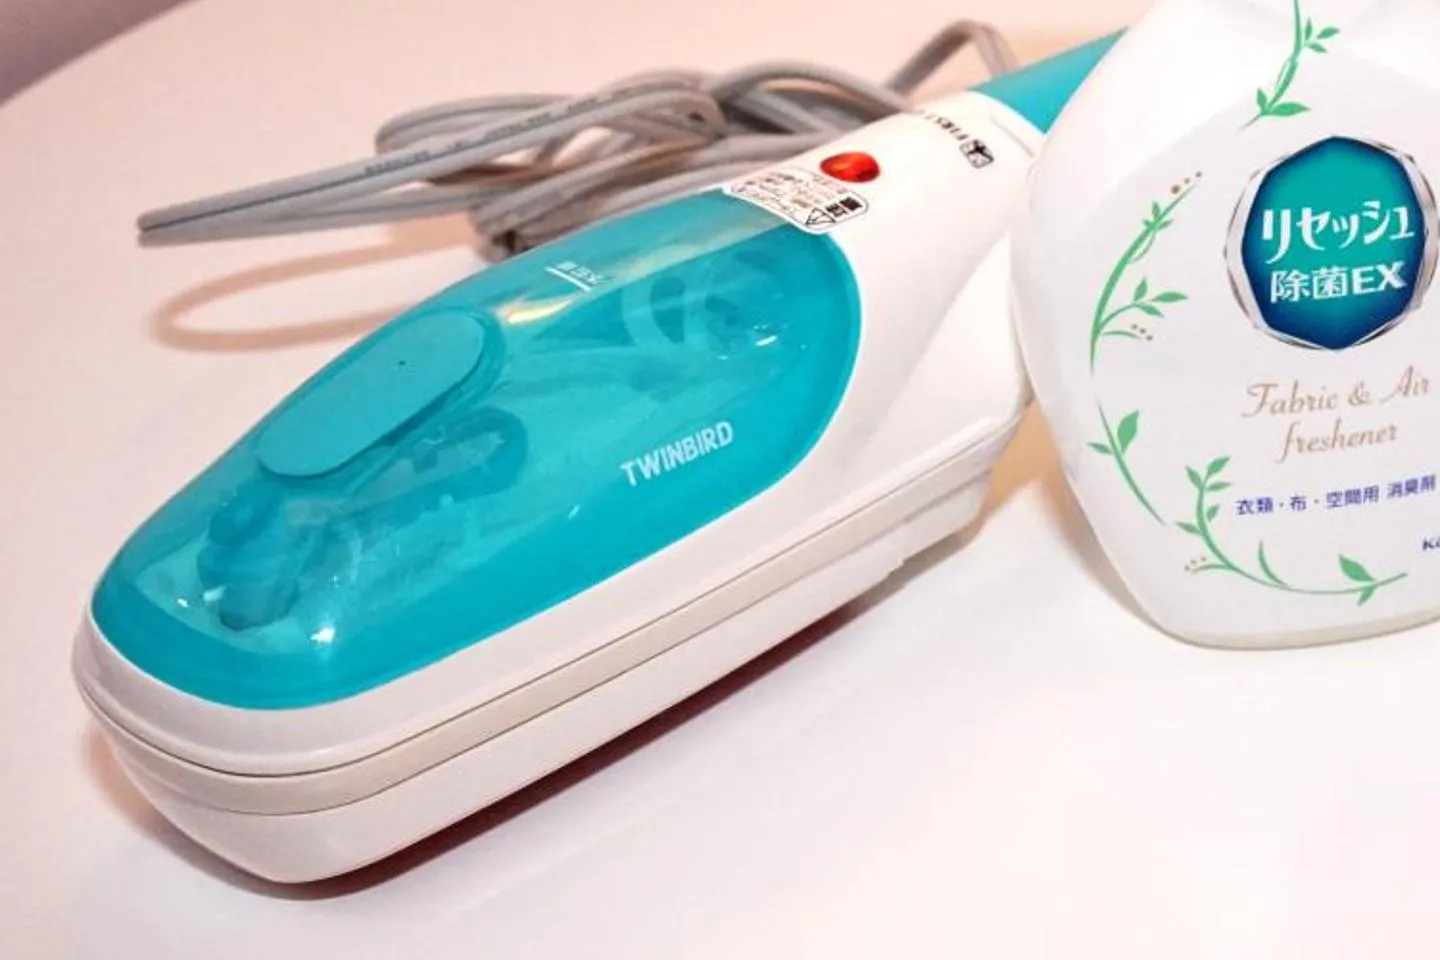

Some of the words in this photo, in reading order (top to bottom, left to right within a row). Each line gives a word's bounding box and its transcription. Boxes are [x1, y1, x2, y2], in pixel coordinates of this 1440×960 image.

[1262, 200, 1415, 264] リセッシュ
[1270, 260, 1408, 303] 除菌EX
[1241, 379, 1339, 418] Fabric
[1347, 381, 1372, 407] &
[1379, 365, 1430, 404] Air
[619, 421, 733, 487] TWINBIRD
[1276, 417, 1398, 464] freshener
